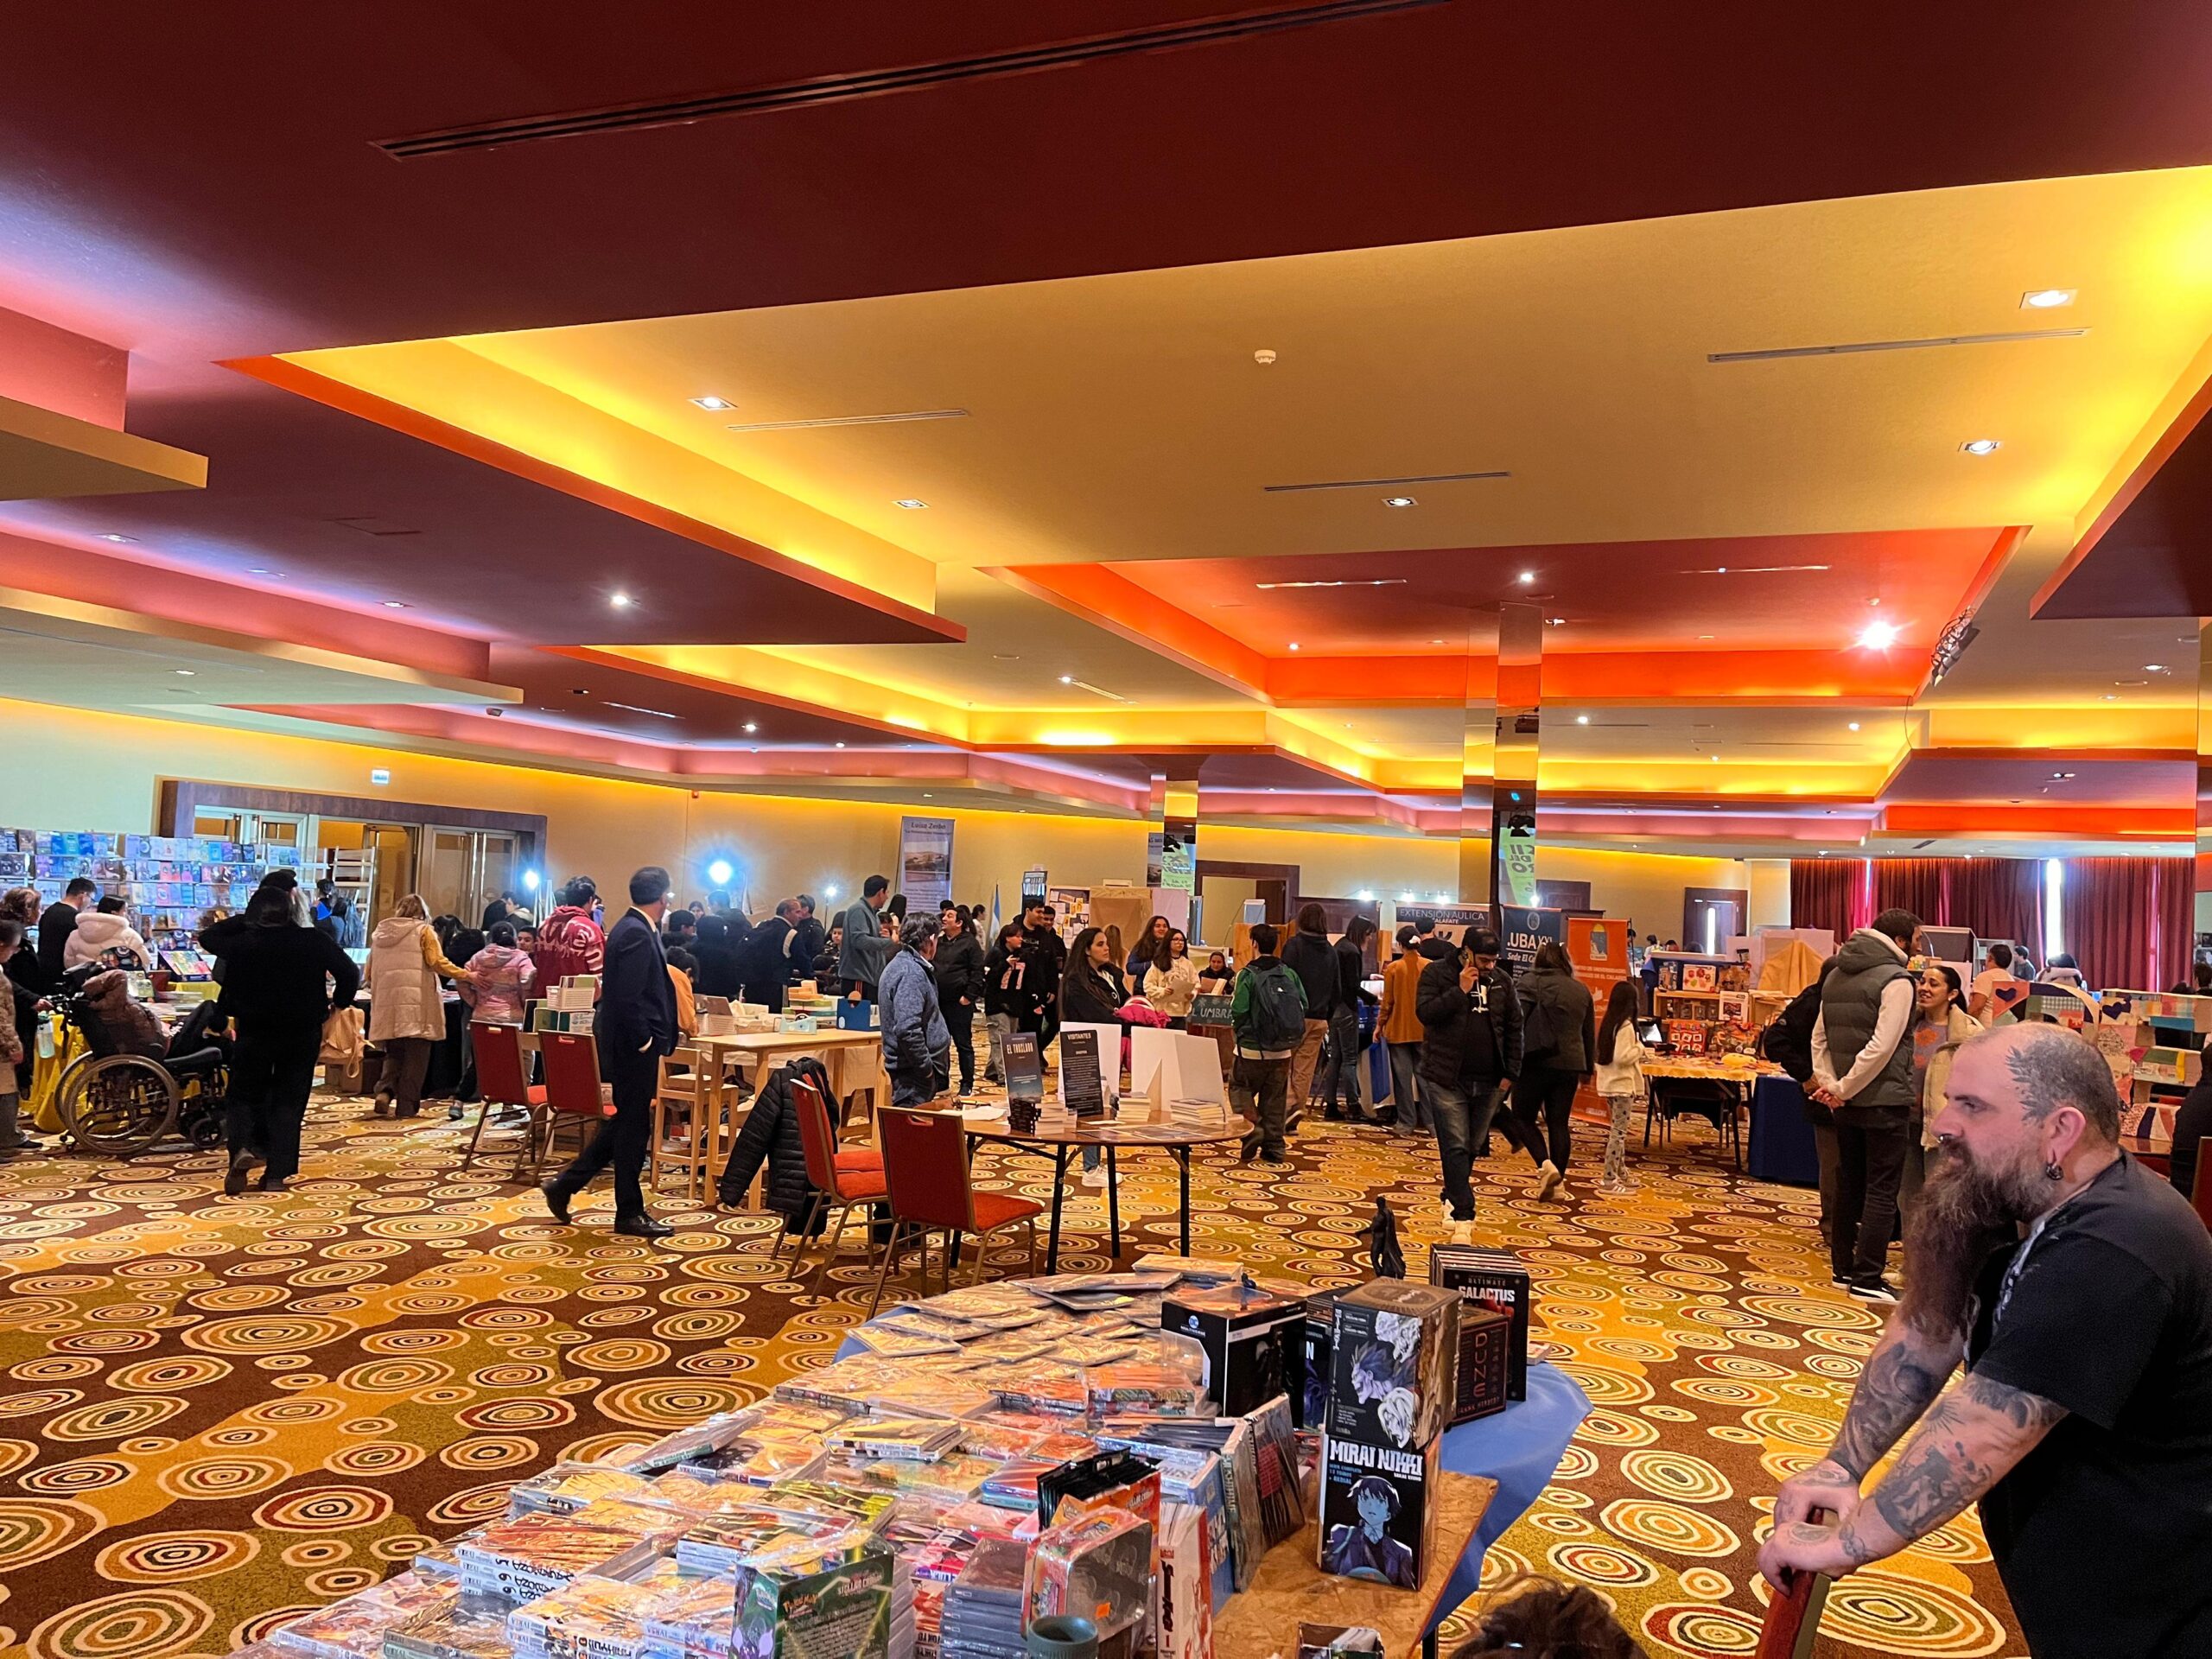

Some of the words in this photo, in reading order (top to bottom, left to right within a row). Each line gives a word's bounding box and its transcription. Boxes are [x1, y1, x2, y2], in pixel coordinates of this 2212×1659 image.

[1507, 952, 1521, 962] Sede
[1522, 953, 1529, 962] El
[1200, 1007, 1233, 1019] UMBRA
[1459, 1286, 1516, 1302] GALACTUS
[1473, 1332, 1488, 1397] DUNE
[1330, 1440, 1376, 1468] MIRAI
[1377, 1448, 1423, 1476] NIKKI
